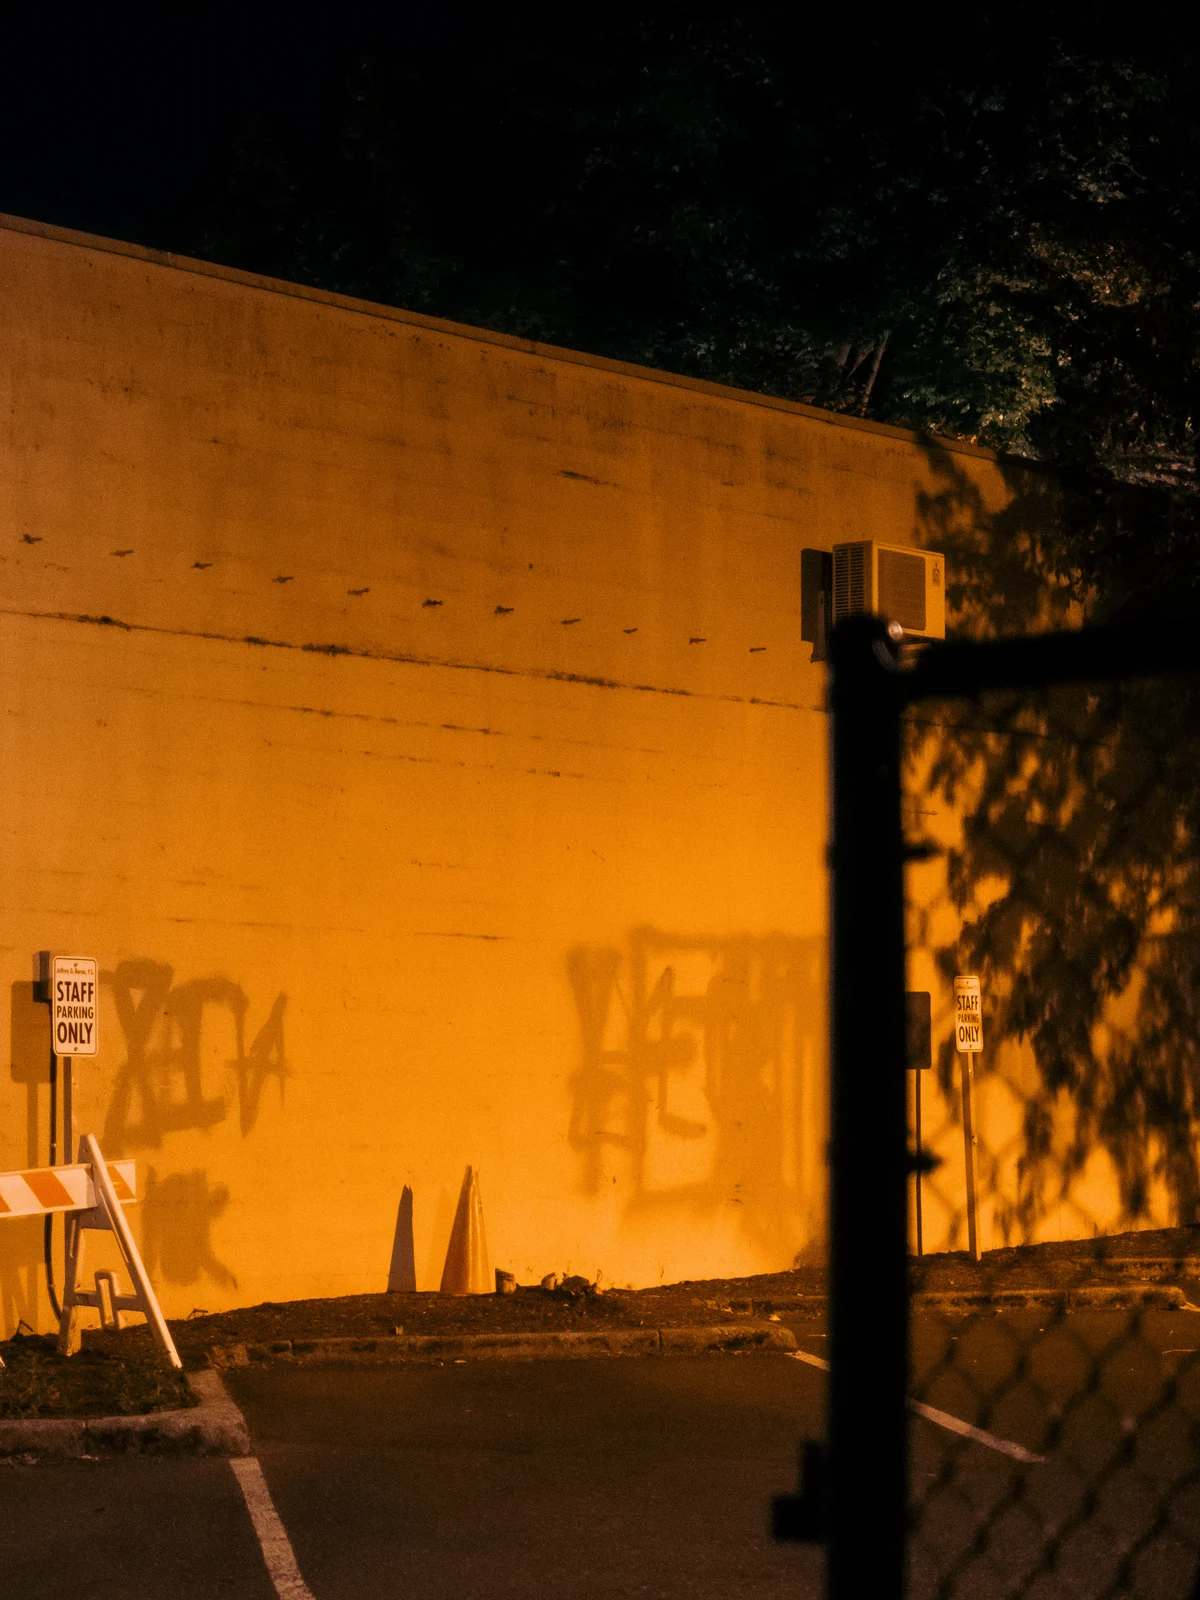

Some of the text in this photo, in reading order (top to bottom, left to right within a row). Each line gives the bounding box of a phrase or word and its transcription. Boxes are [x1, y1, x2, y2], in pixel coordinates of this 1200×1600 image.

[57, 981, 94, 1002] STAFF
[958, 995, 978, 1011] STAFF
[57, 1005, 94, 1019] PARKING
[958, 1014, 979, 1024] PARKING
[57, 1021, 93, 1044] ONLY
[959, 1026, 979, 1042] ONLY
